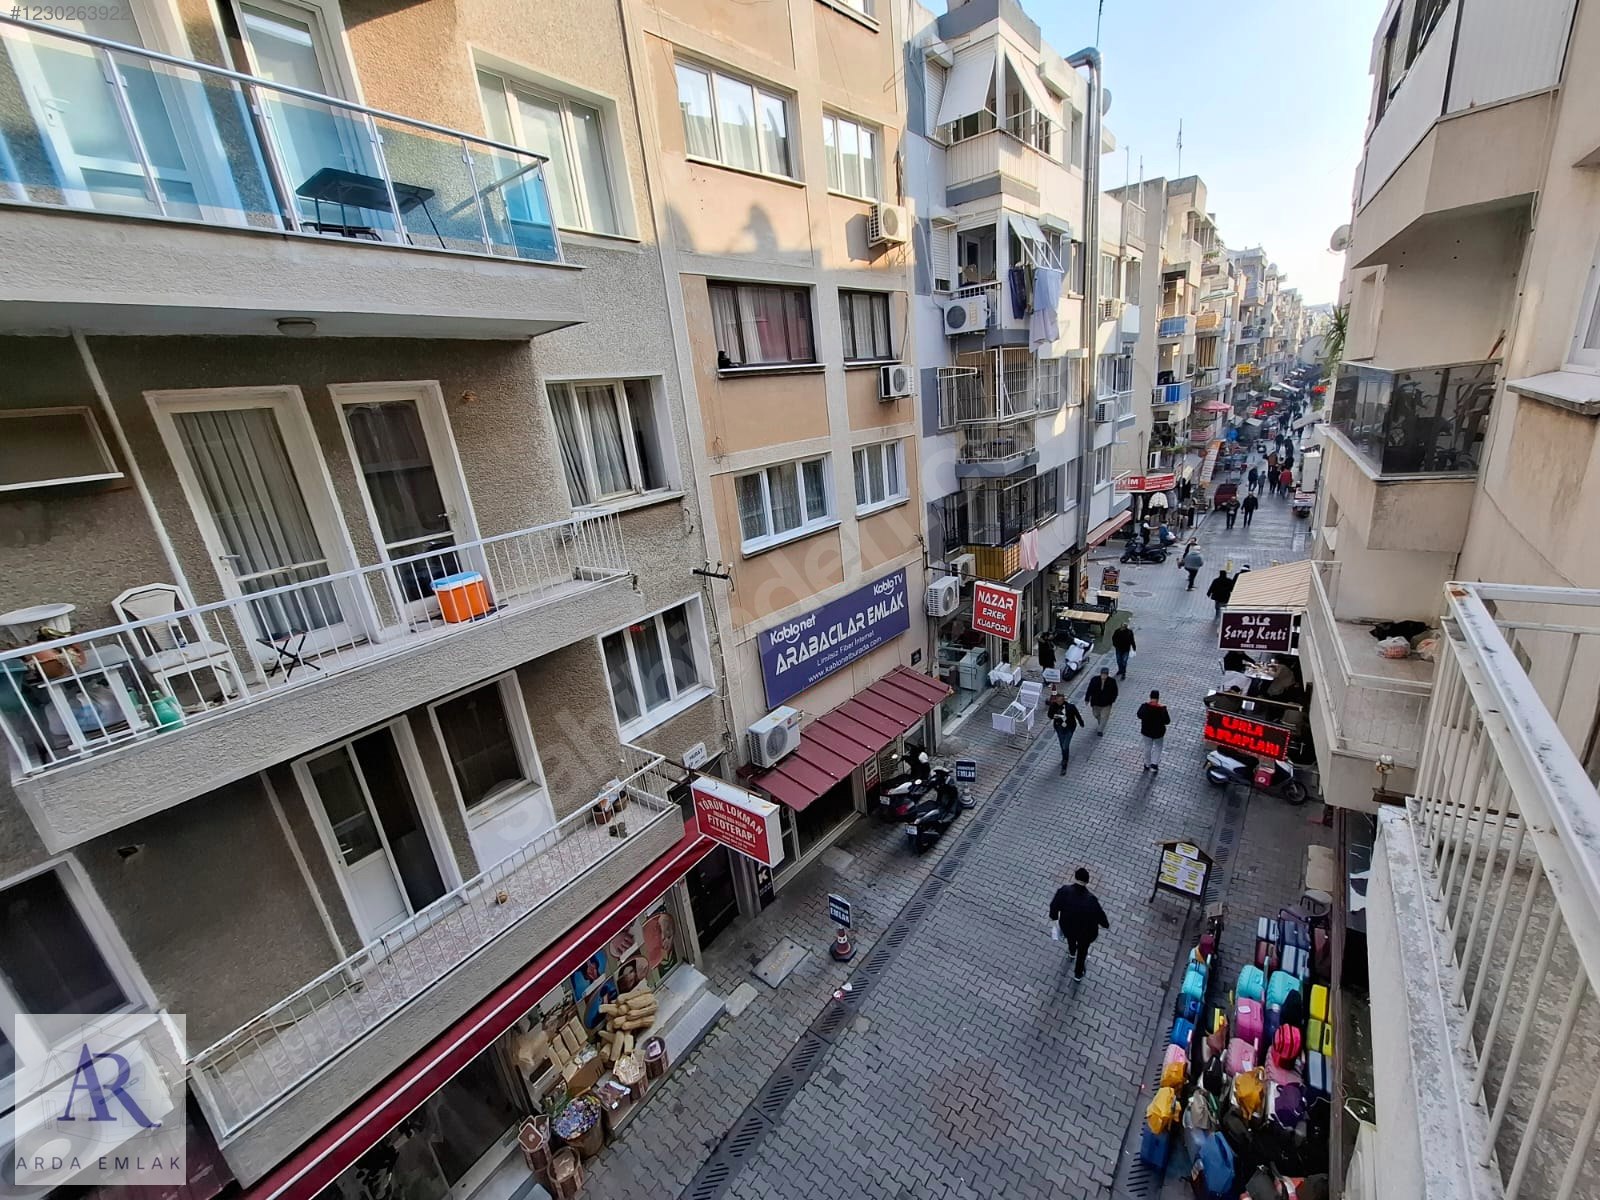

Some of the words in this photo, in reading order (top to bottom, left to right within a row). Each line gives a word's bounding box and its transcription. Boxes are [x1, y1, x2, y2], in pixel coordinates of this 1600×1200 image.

[977, 590, 1014, 611] NAZAR
[982, 607, 1007, 621] ERKEK
[775, 611, 866, 676] ARABACILAR
[867, 591, 905, 627] EMLAK
[1224, 625, 1255, 643] Şarap
[1256, 626, 1288, 641] Kenti
[726, 804, 764, 835] LOKMAN
